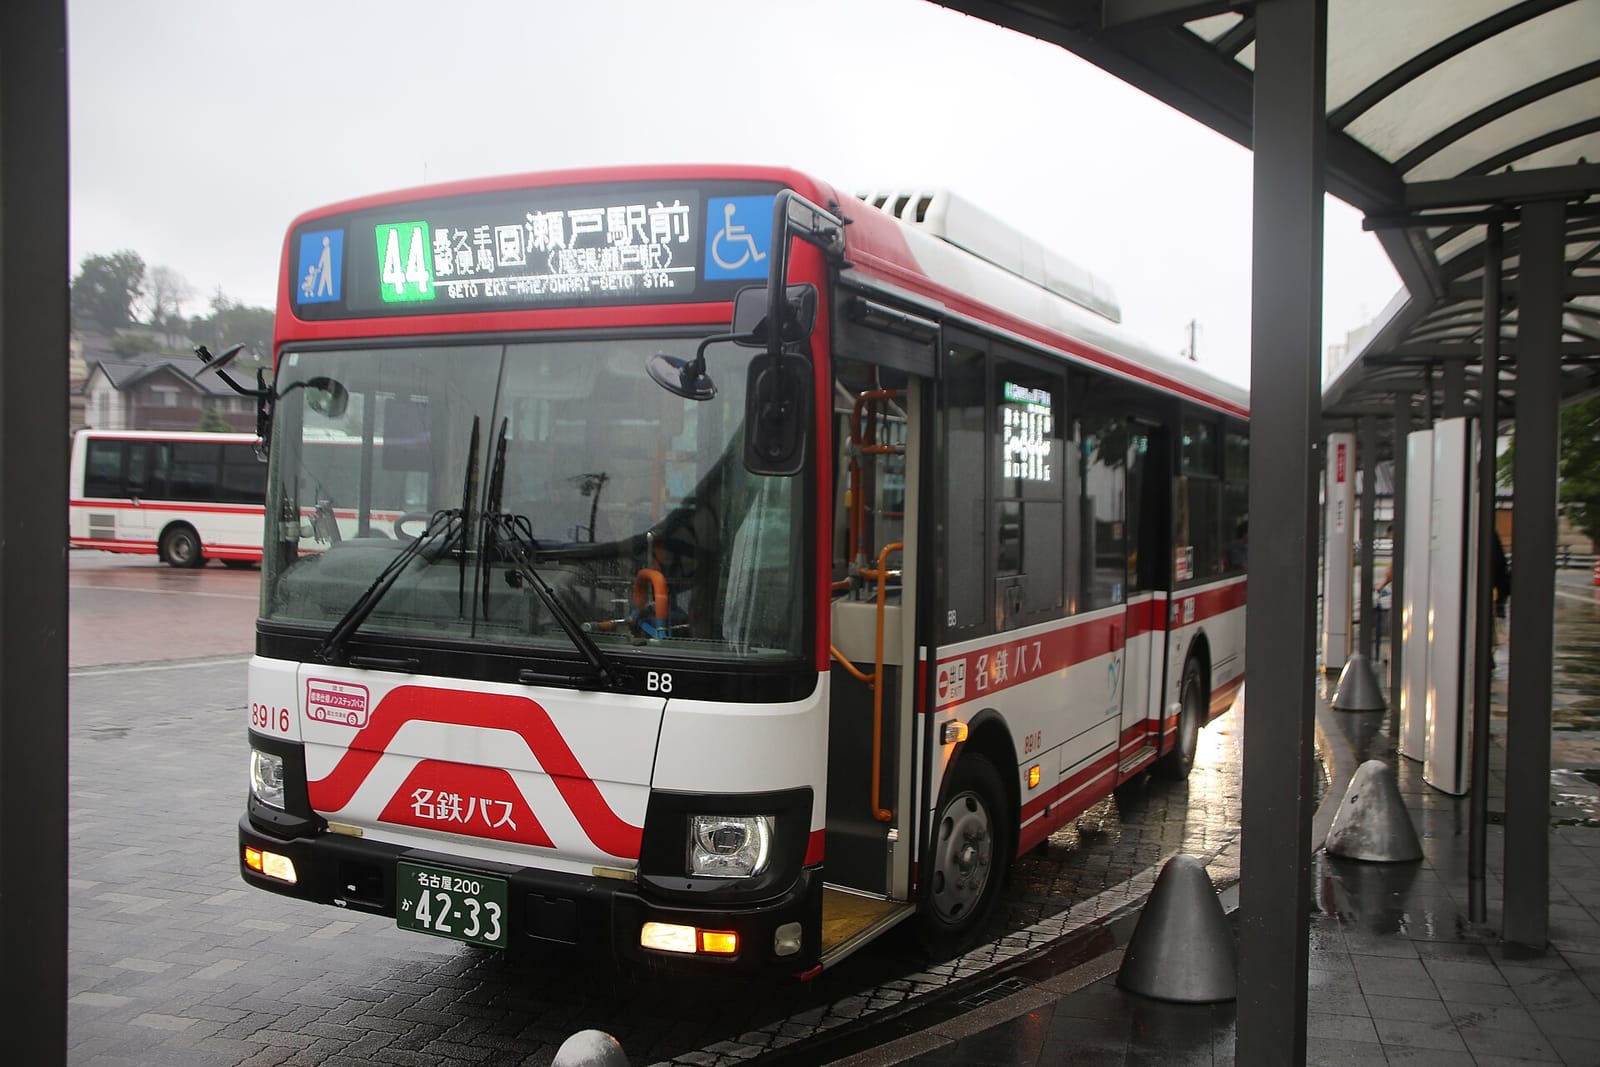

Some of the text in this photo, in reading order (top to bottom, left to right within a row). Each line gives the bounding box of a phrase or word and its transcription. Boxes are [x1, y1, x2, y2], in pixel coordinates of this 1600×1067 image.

[526, 200, 689, 252] 瀬戸駅前
[383, 227, 430, 294] 44
[448, 284, 478, 299] SETO
[643, 273, 674, 288] STA.
[647, 672, 672, 692] B8
[950, 664, 965, 685] 出口
[975, 641, 1042, 691] 名鉄バス
[252, 703, 289, 732] 8916
[1024, 730, 1042, 754] 8916
[411, 788, 517, 830] 名鉄バス
[401, 890, 501, 941] か 42-33
